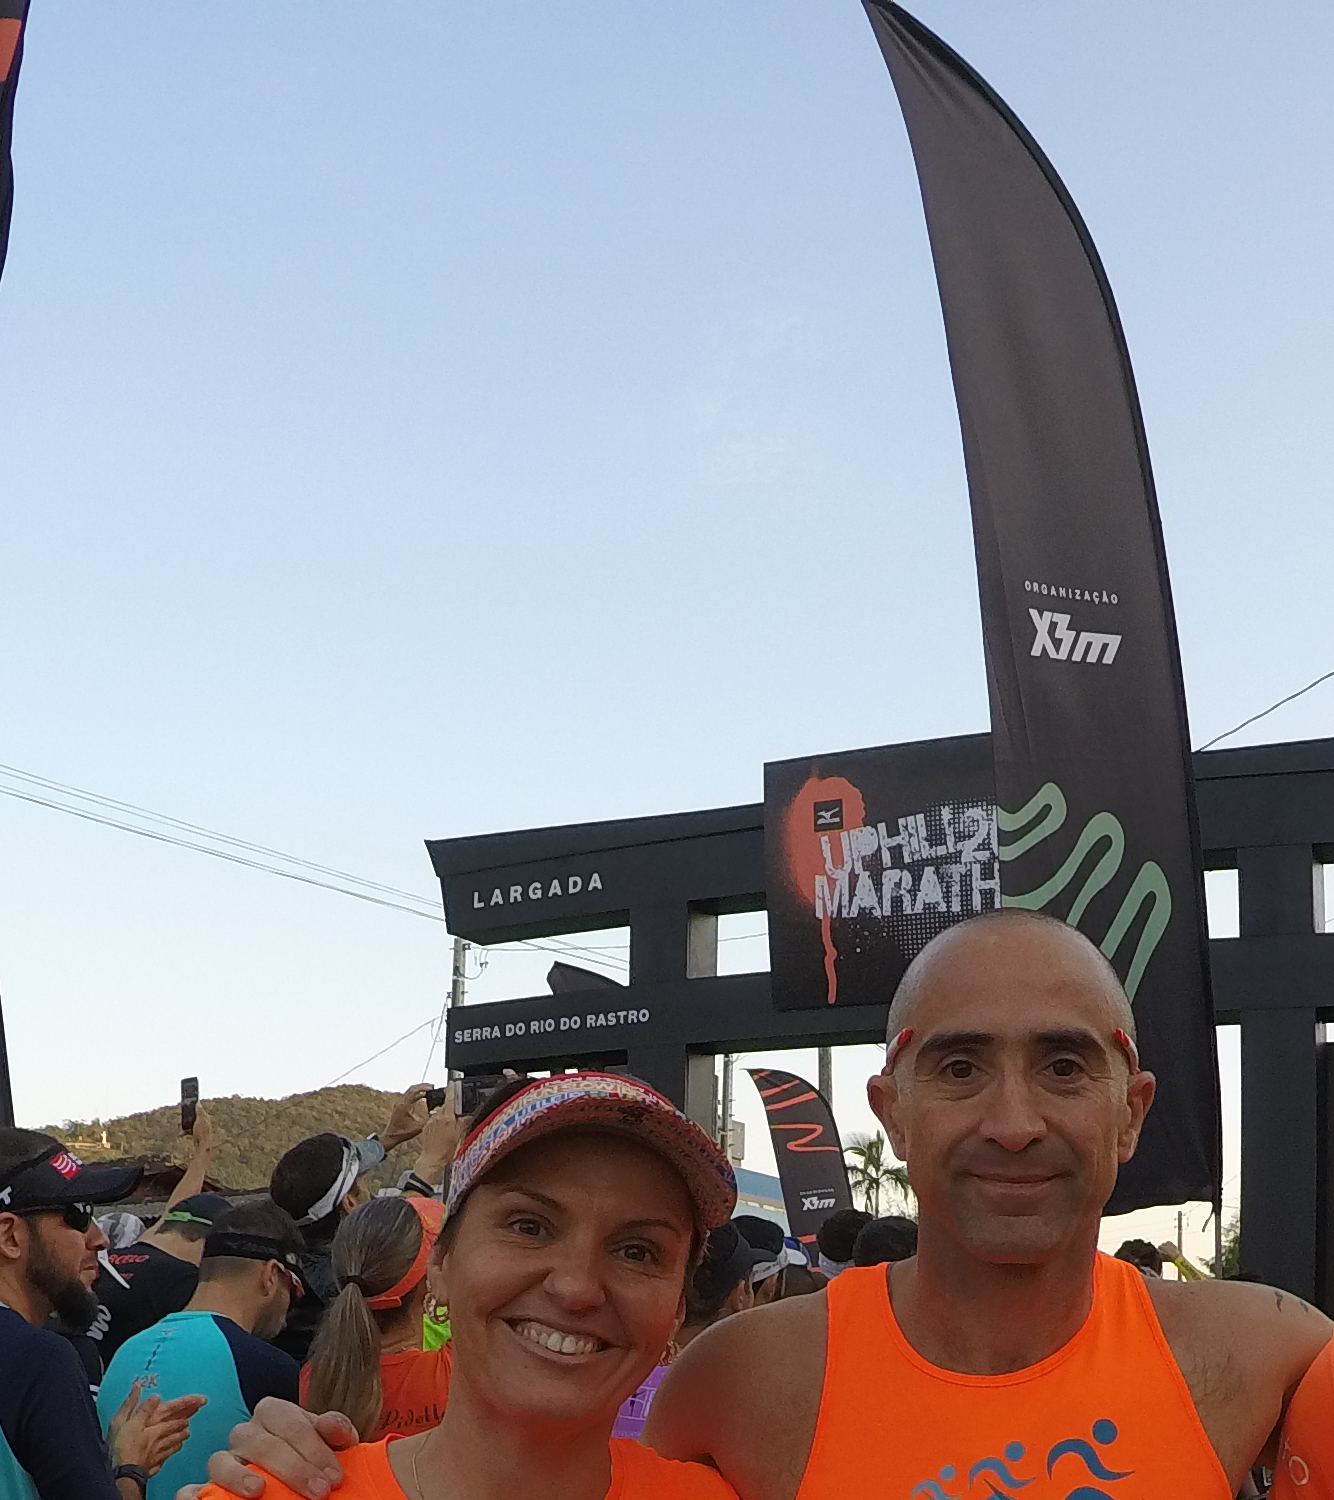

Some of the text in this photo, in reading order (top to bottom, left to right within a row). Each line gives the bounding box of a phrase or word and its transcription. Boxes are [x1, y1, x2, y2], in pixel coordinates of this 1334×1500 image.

[1024, 580, 1119, 605] ORGANIZAÇÃO
[473, 873, 603, 909] LARGADA
[814, 862, 1001, 919] MARATH
[454, 1008, 650, 1043] SERRA DO RIO DO RASTRO
